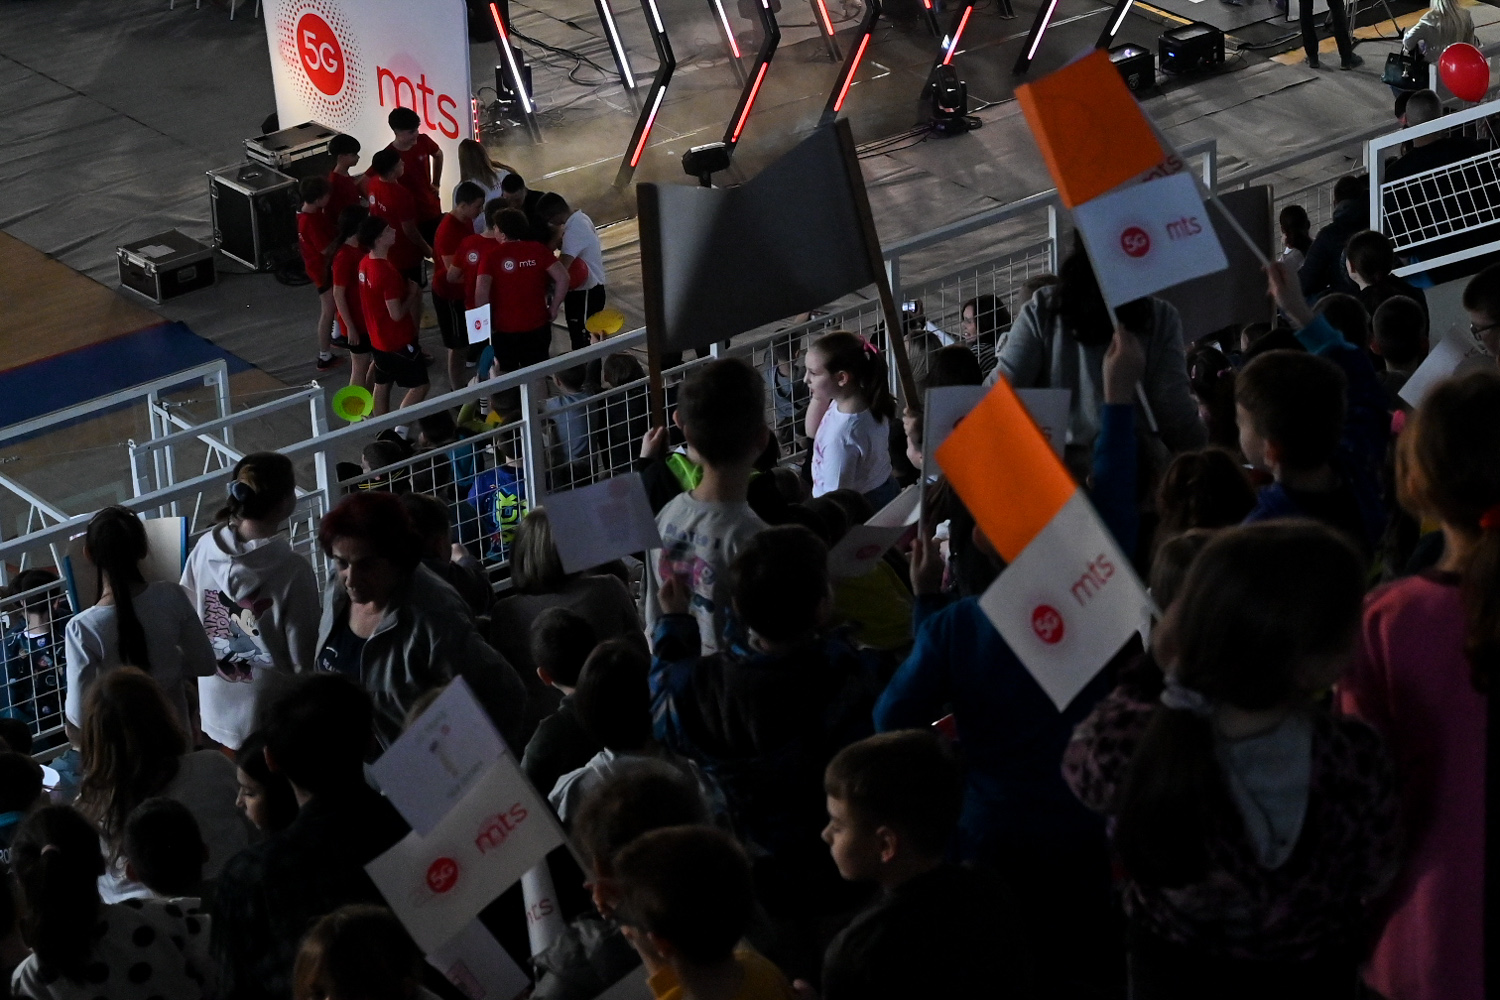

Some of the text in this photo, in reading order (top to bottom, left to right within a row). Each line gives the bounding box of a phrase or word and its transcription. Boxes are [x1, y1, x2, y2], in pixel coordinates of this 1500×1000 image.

[303, 29, 459, 139] 5G mts
[1166, 216, 1202, 241] mts
[518, 258, 537, 268] mts
[1070, 554, 1115, 607] mts
[474, 802, 529, 854] mts
